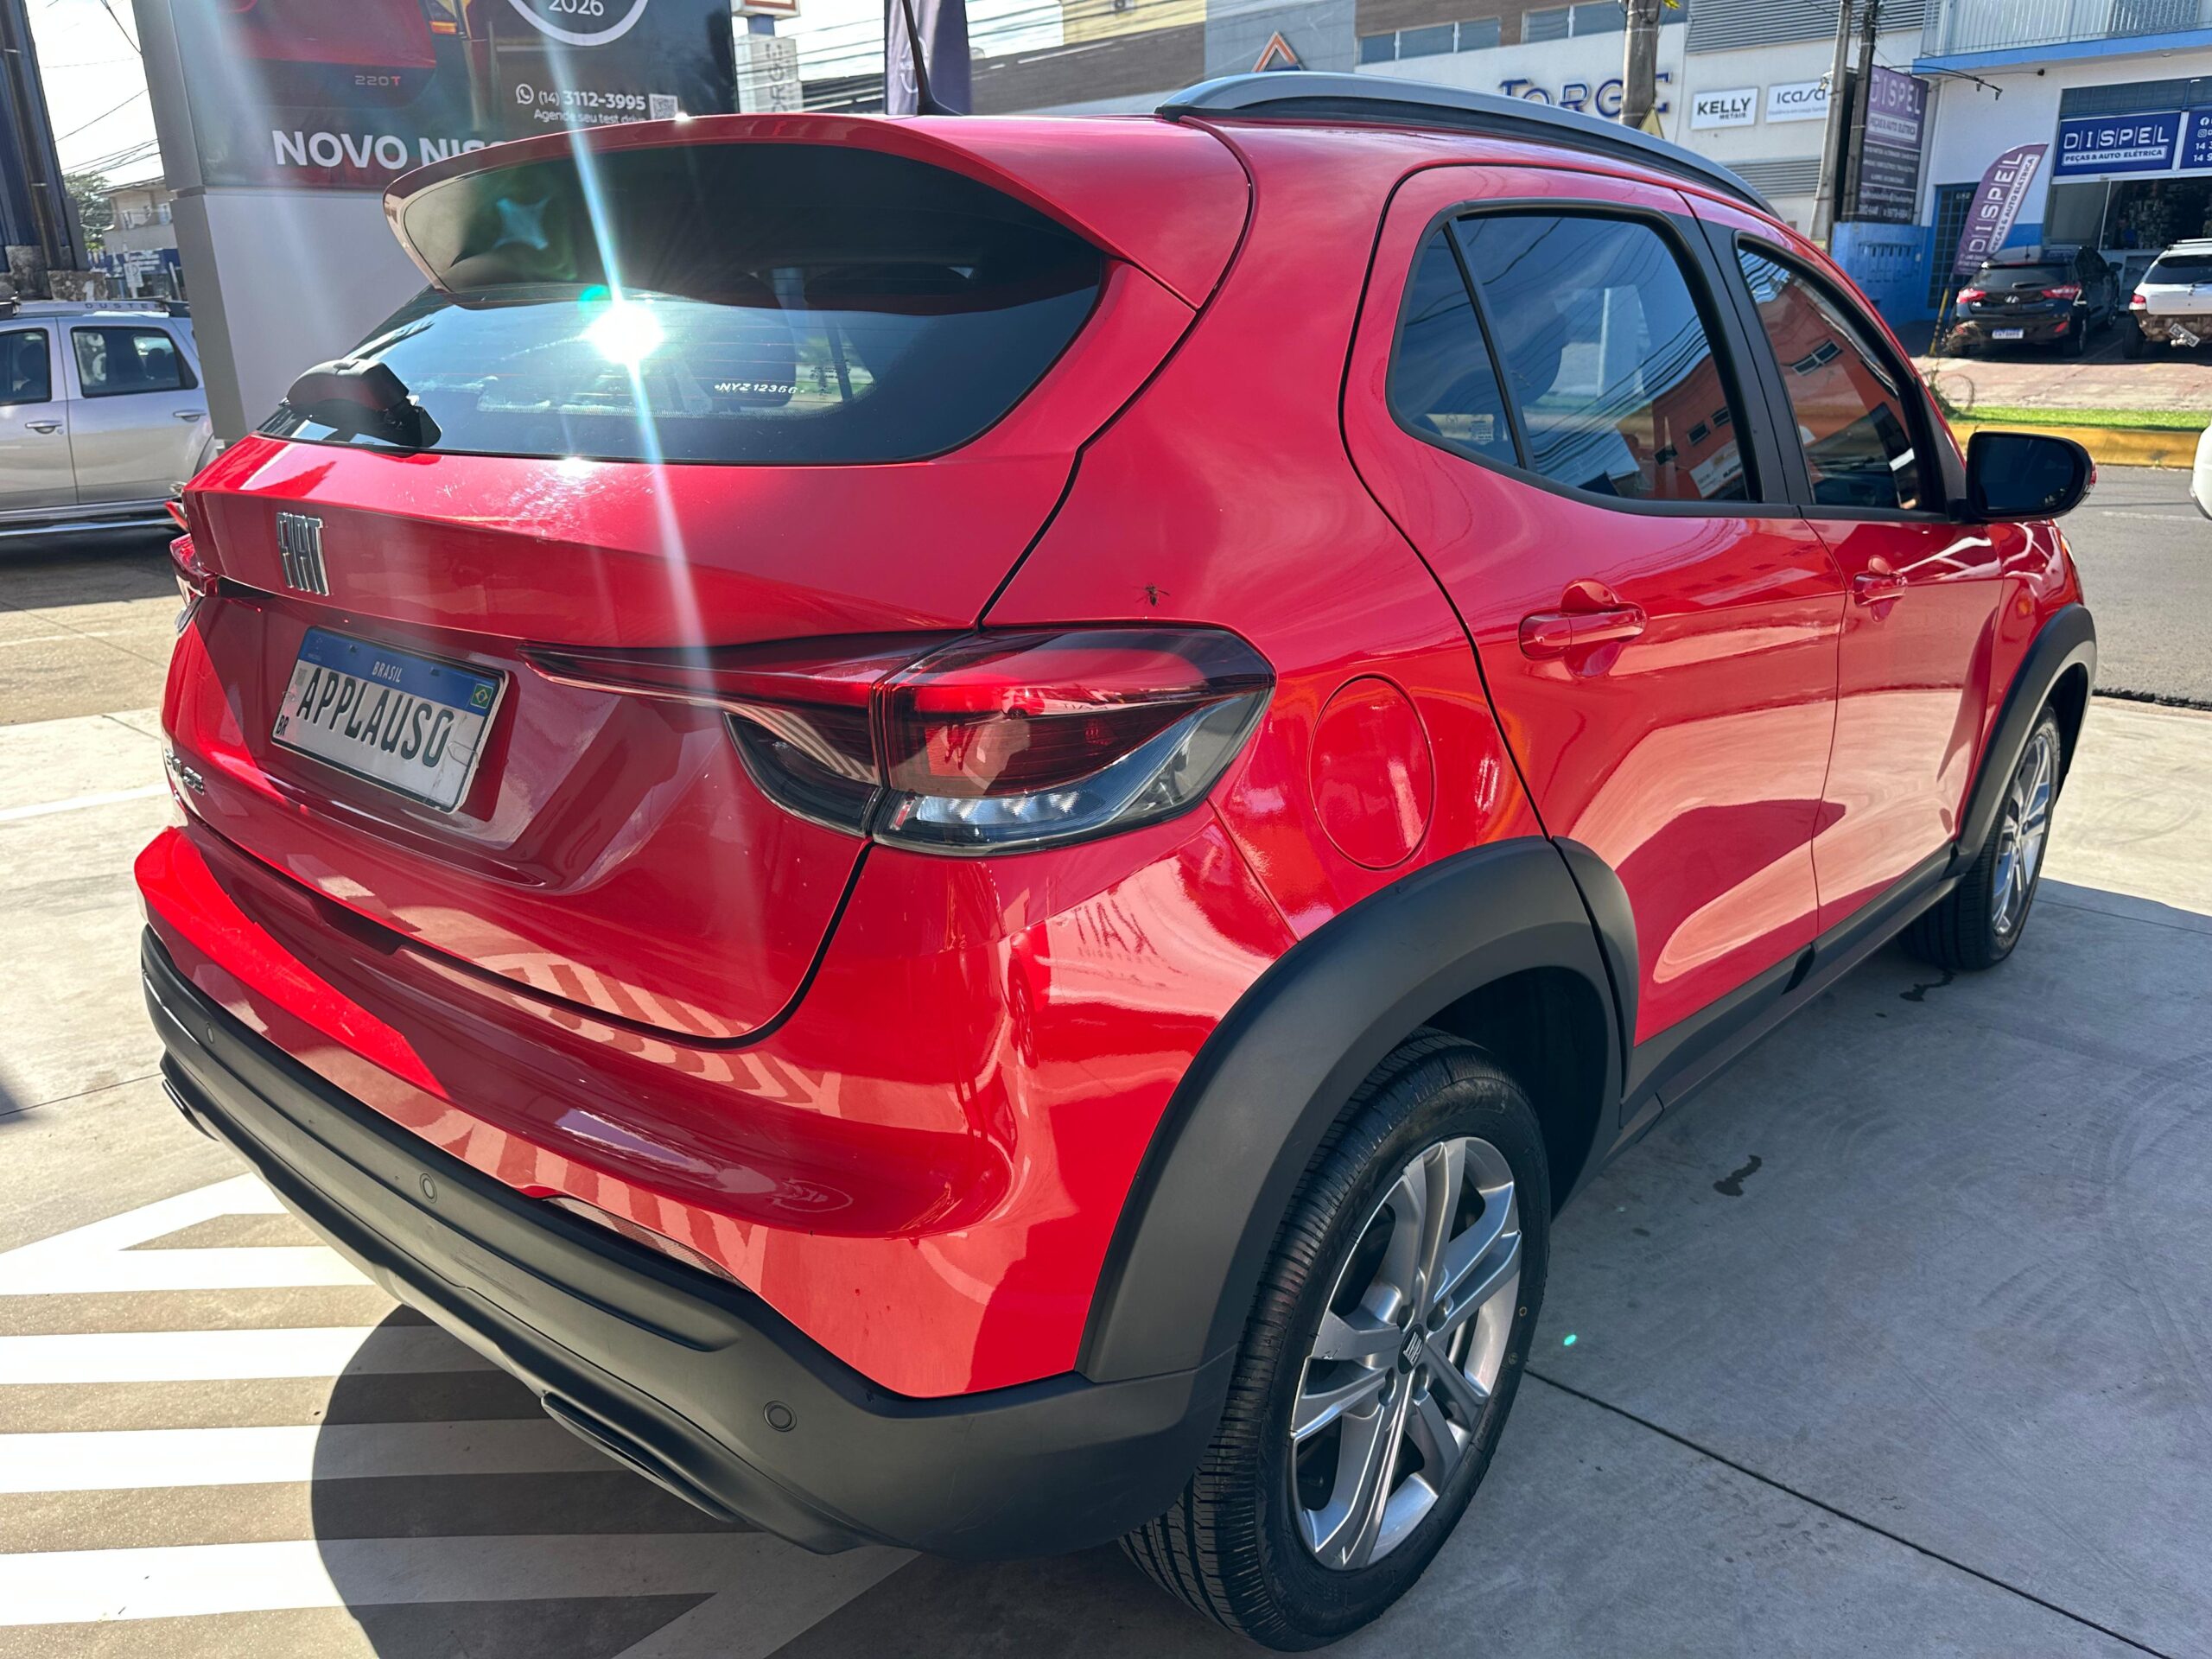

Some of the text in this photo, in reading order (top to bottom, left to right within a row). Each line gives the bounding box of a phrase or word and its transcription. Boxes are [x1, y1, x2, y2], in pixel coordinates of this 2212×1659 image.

[549, 0, 604, 16] 2026
[354, 75, 401, 86] 220T
[538, 90, 646, 111] (14) 3112-3995
[1870, 74, 1921, 115] DISPEL
[534, 109, 576, 123] Agende
[579, 112, 597, 123] seu
[598, 112, 618, 124] test
[1697, 97, 1751, 116] KELLY
[2063, 126, 2170, 149] DISPEL
[271, 130, 506, 169] NOVO NI
[2193, 154, 2204, 162] 14
[1968, 153, 2023, 252] DISPEL
[2005, 195, 2017, 217] AUTO
[276, 512, 330, 597] FIAT
[372, 661, 402, 683] BRASIL
[276, 715, 289, 737] BR
[296, 667, 454, 768] APPLAUSO
